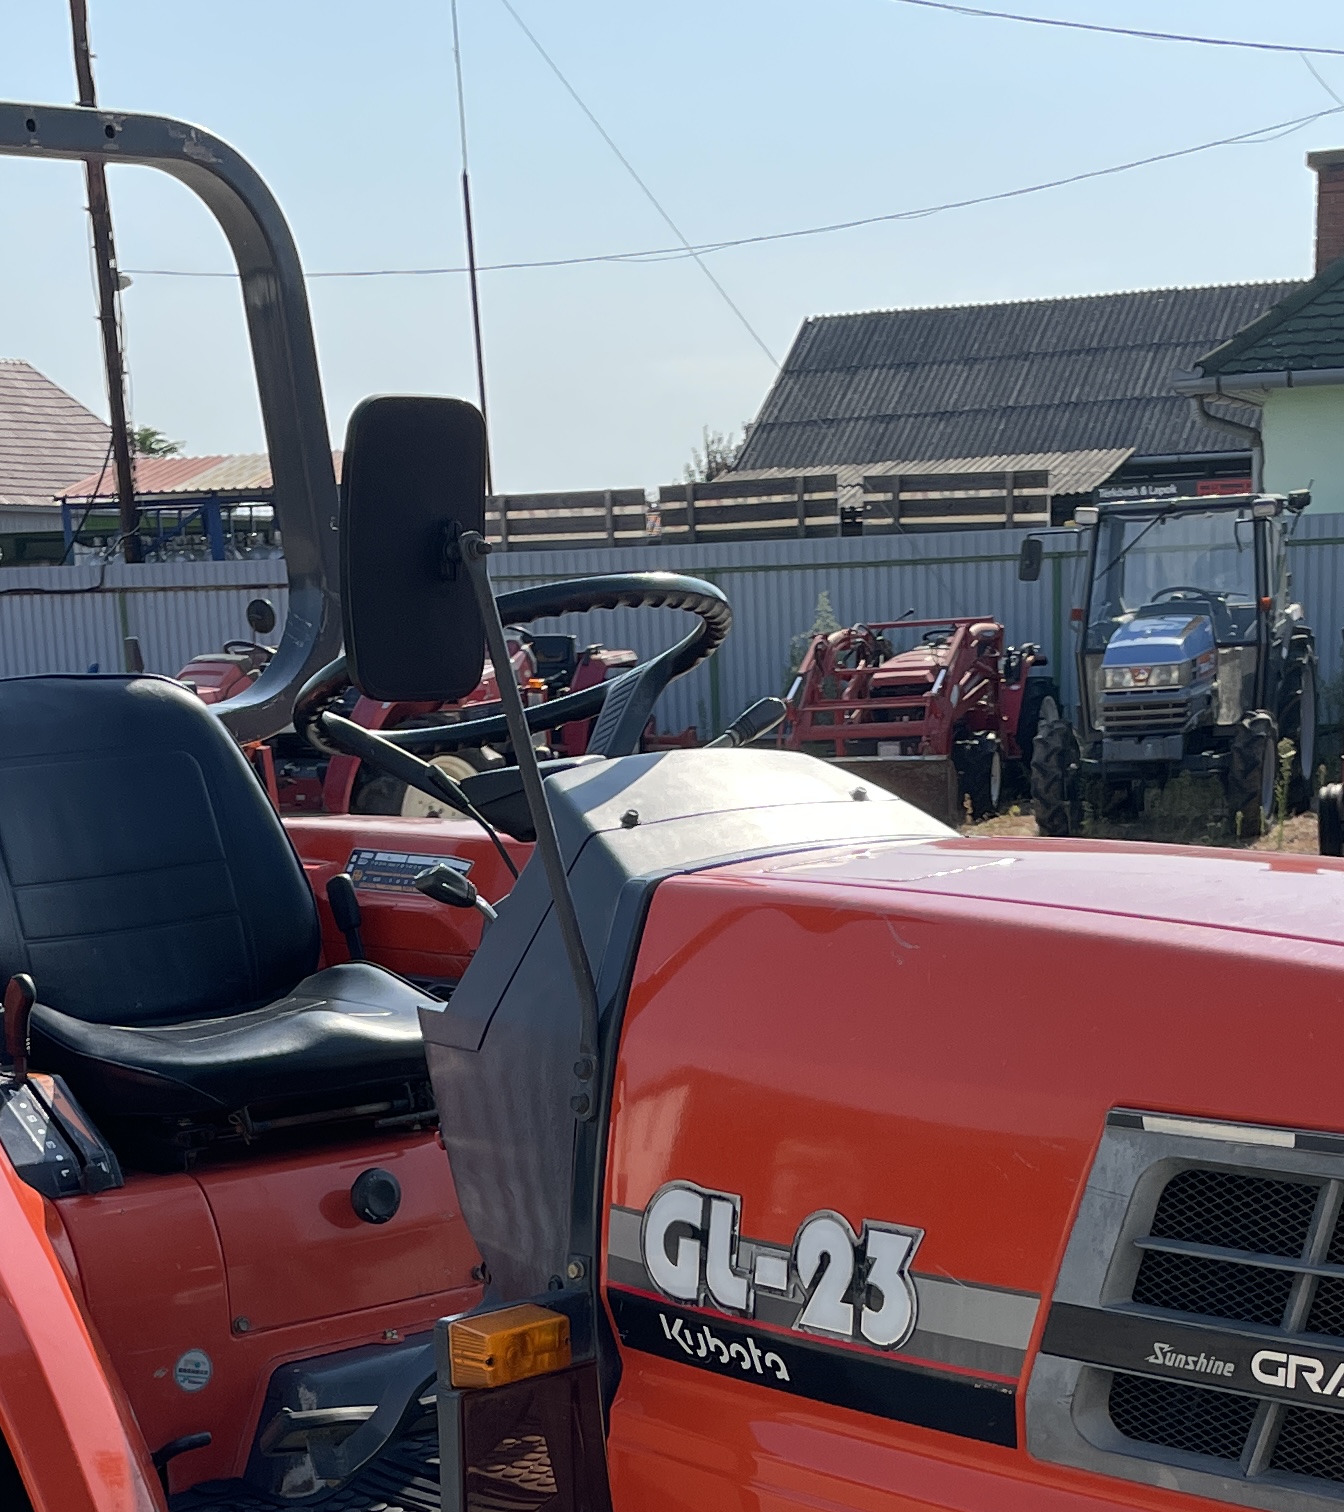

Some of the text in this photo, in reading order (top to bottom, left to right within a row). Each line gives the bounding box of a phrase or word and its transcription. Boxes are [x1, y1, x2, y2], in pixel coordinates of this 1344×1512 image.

[641, 1181, 922, 1349] GL-23
[659, 1313, 790, 1382] Kubota
[1144, 1341, 1236, 1378] Sunshine
